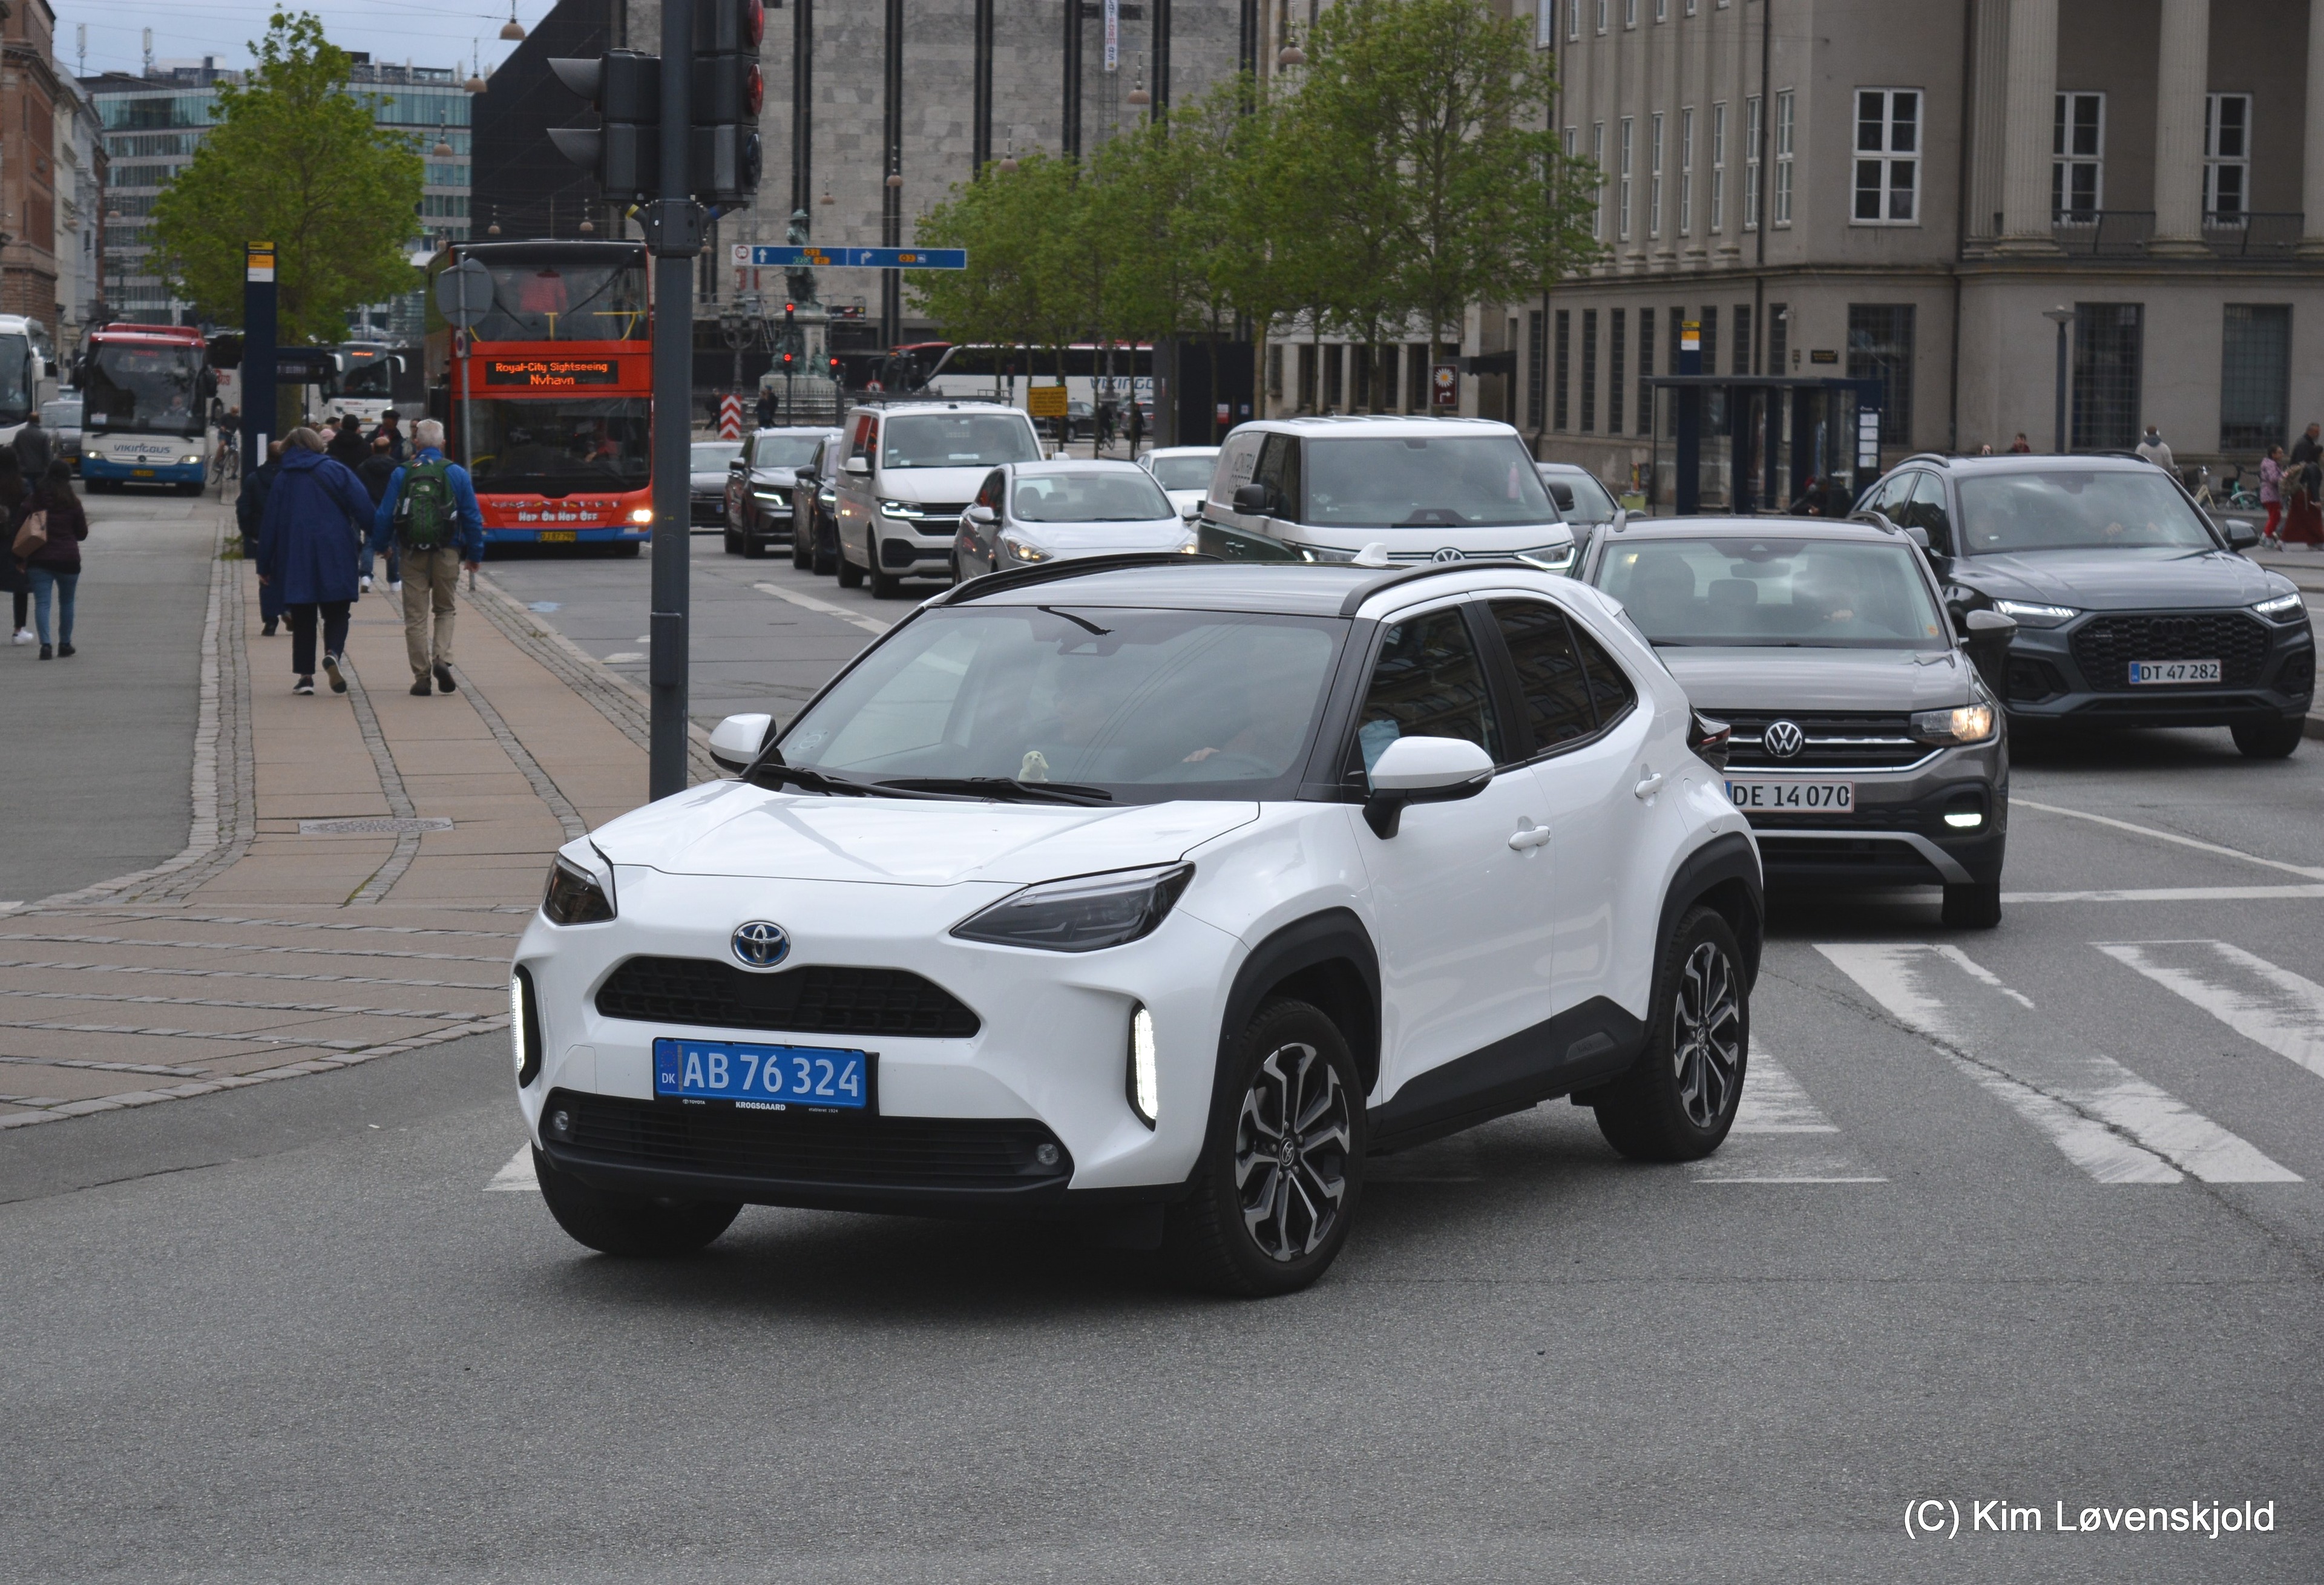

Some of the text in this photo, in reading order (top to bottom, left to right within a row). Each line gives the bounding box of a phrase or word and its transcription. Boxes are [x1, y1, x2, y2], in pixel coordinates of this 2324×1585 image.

[496, 362, 608, 373] Royal-City Sightseeing
[2141, 666, 2163, 680] DT
[2167, 665, 2186, 680] 47
[2190, 663, 2218, 679] 282
[1733, 785, 1850, 807] DE 14 070
[661, 1052, 858, 1097] DK AB 76 324
[735, 1101, 786, 1111] KROGSGAARD
